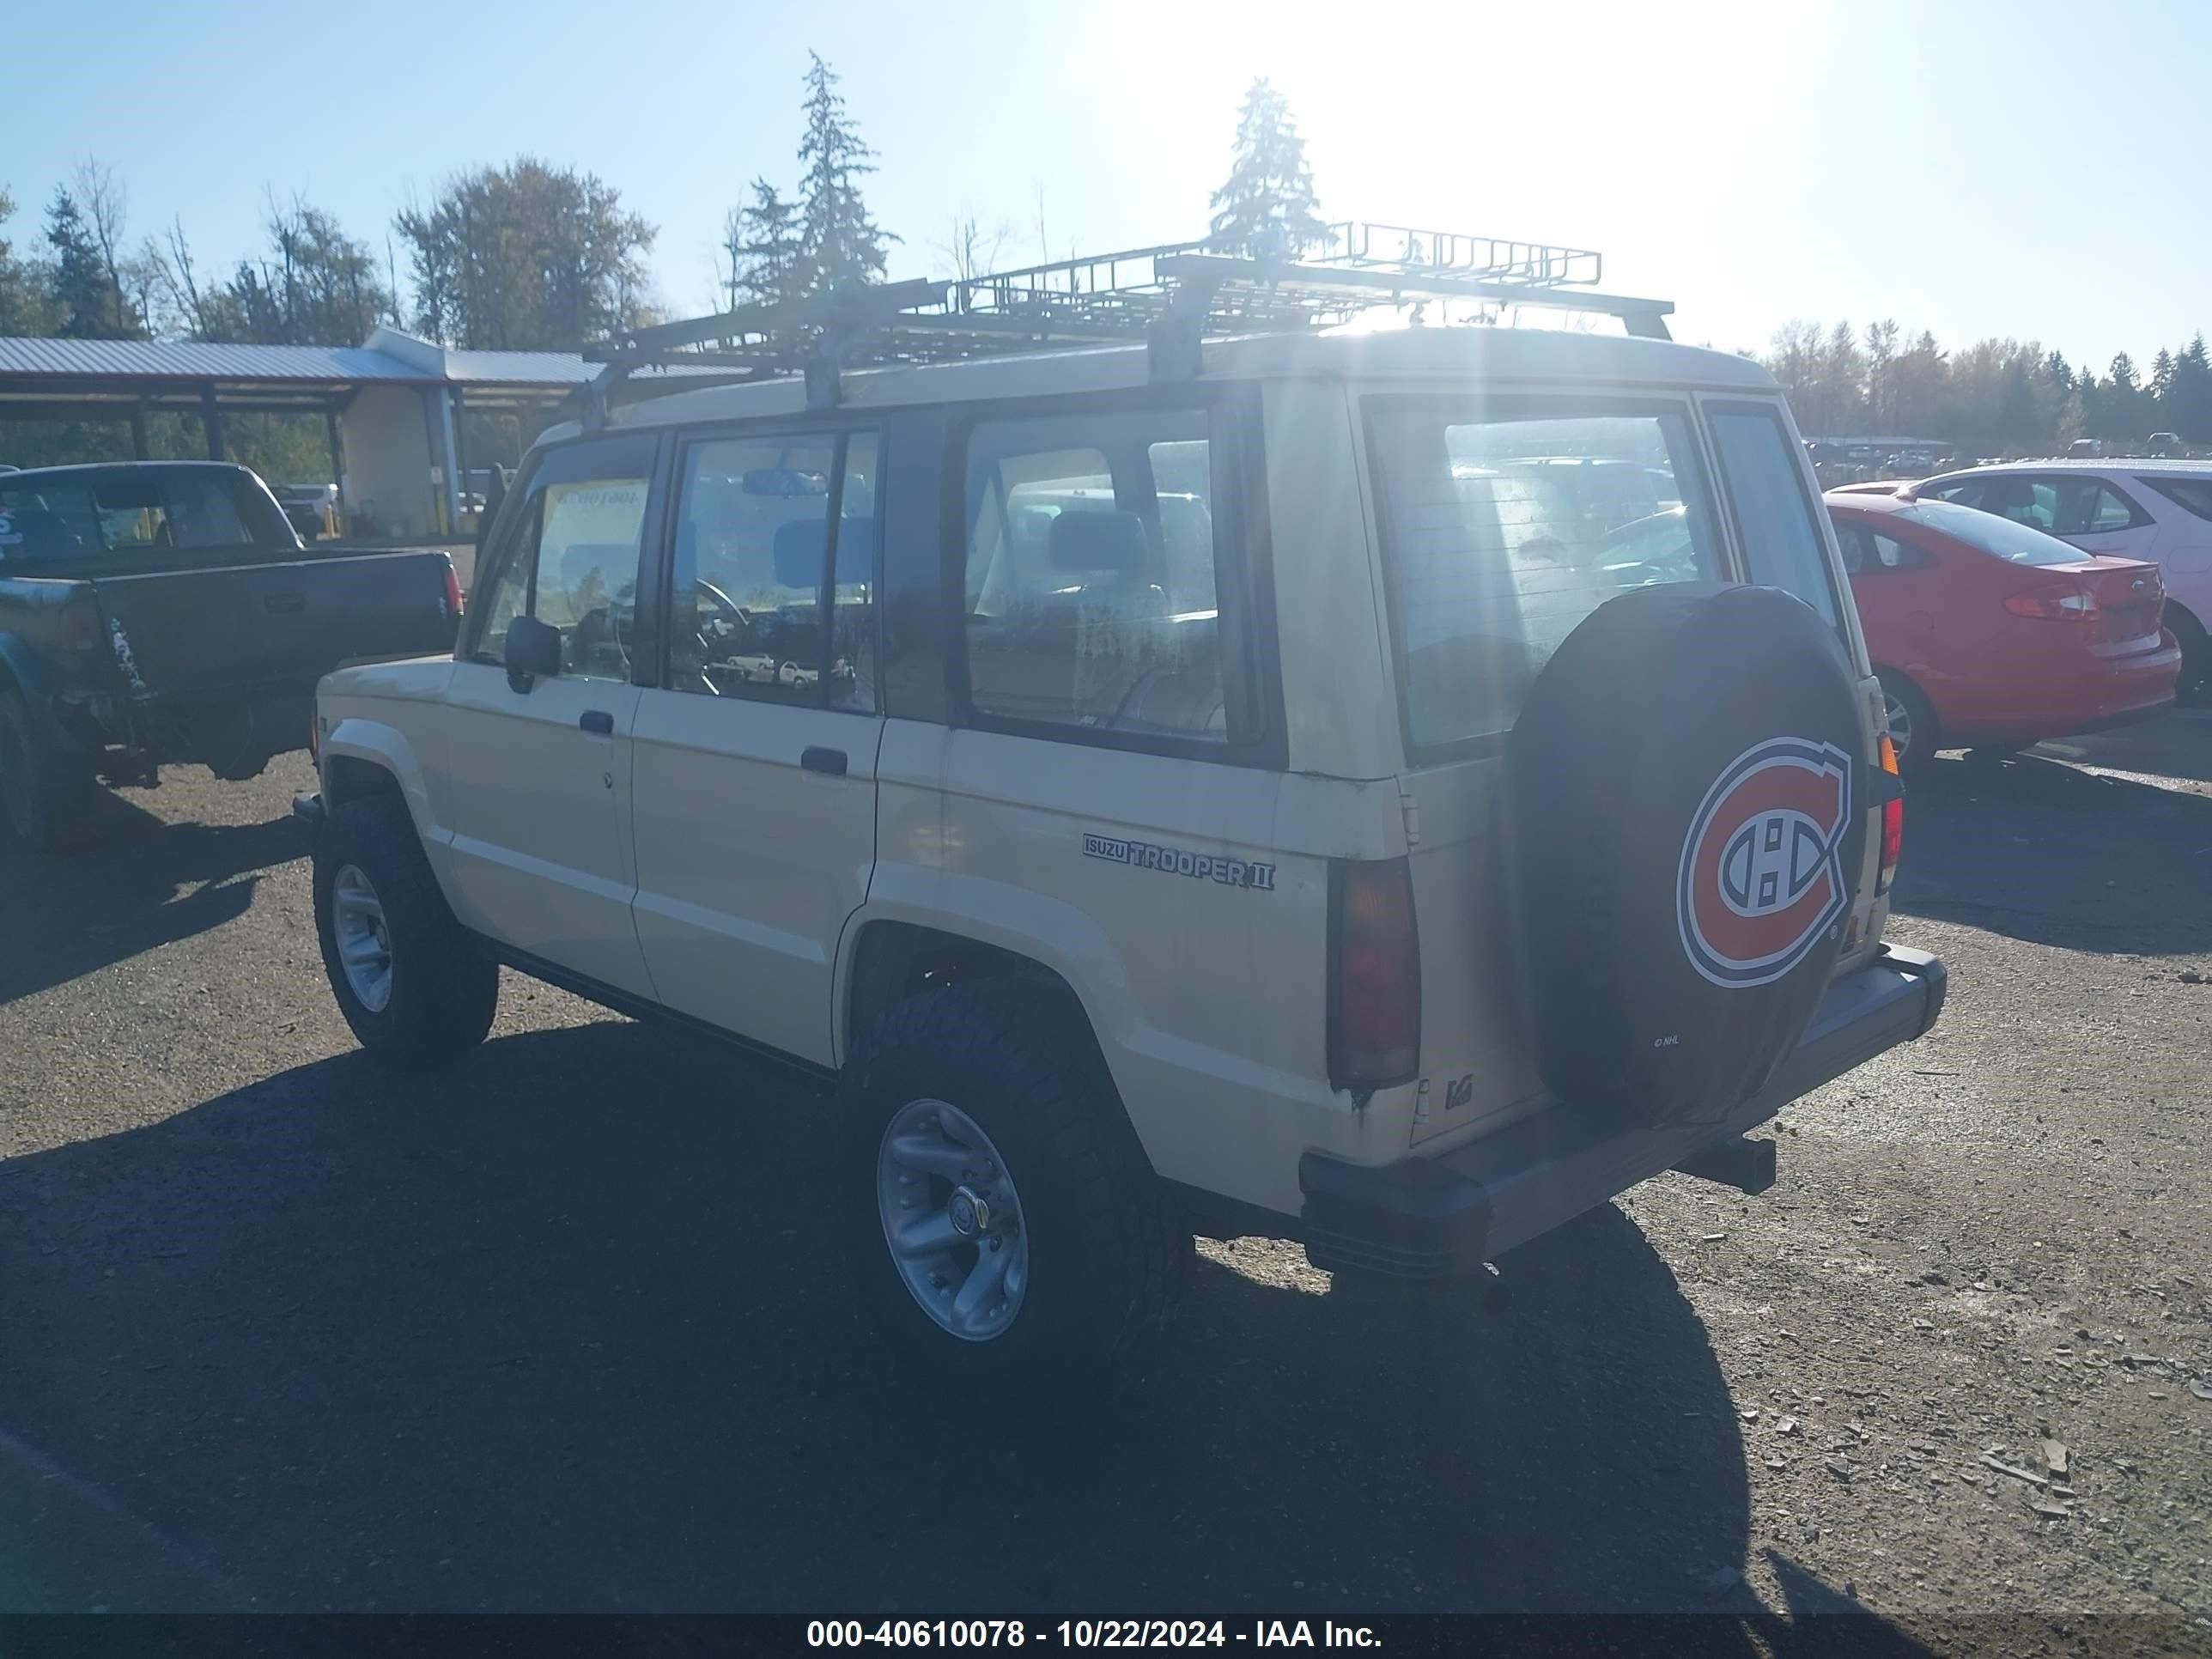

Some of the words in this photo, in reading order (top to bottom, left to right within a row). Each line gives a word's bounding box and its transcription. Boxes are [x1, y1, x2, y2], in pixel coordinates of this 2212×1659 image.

[1085, 836, 1126, 860] ISUZU
[1129, 841, 1249, 888] TROOPER
[1250, 861, 1276, 891] II
[1662, 1035, 1680, 1046] NHL
